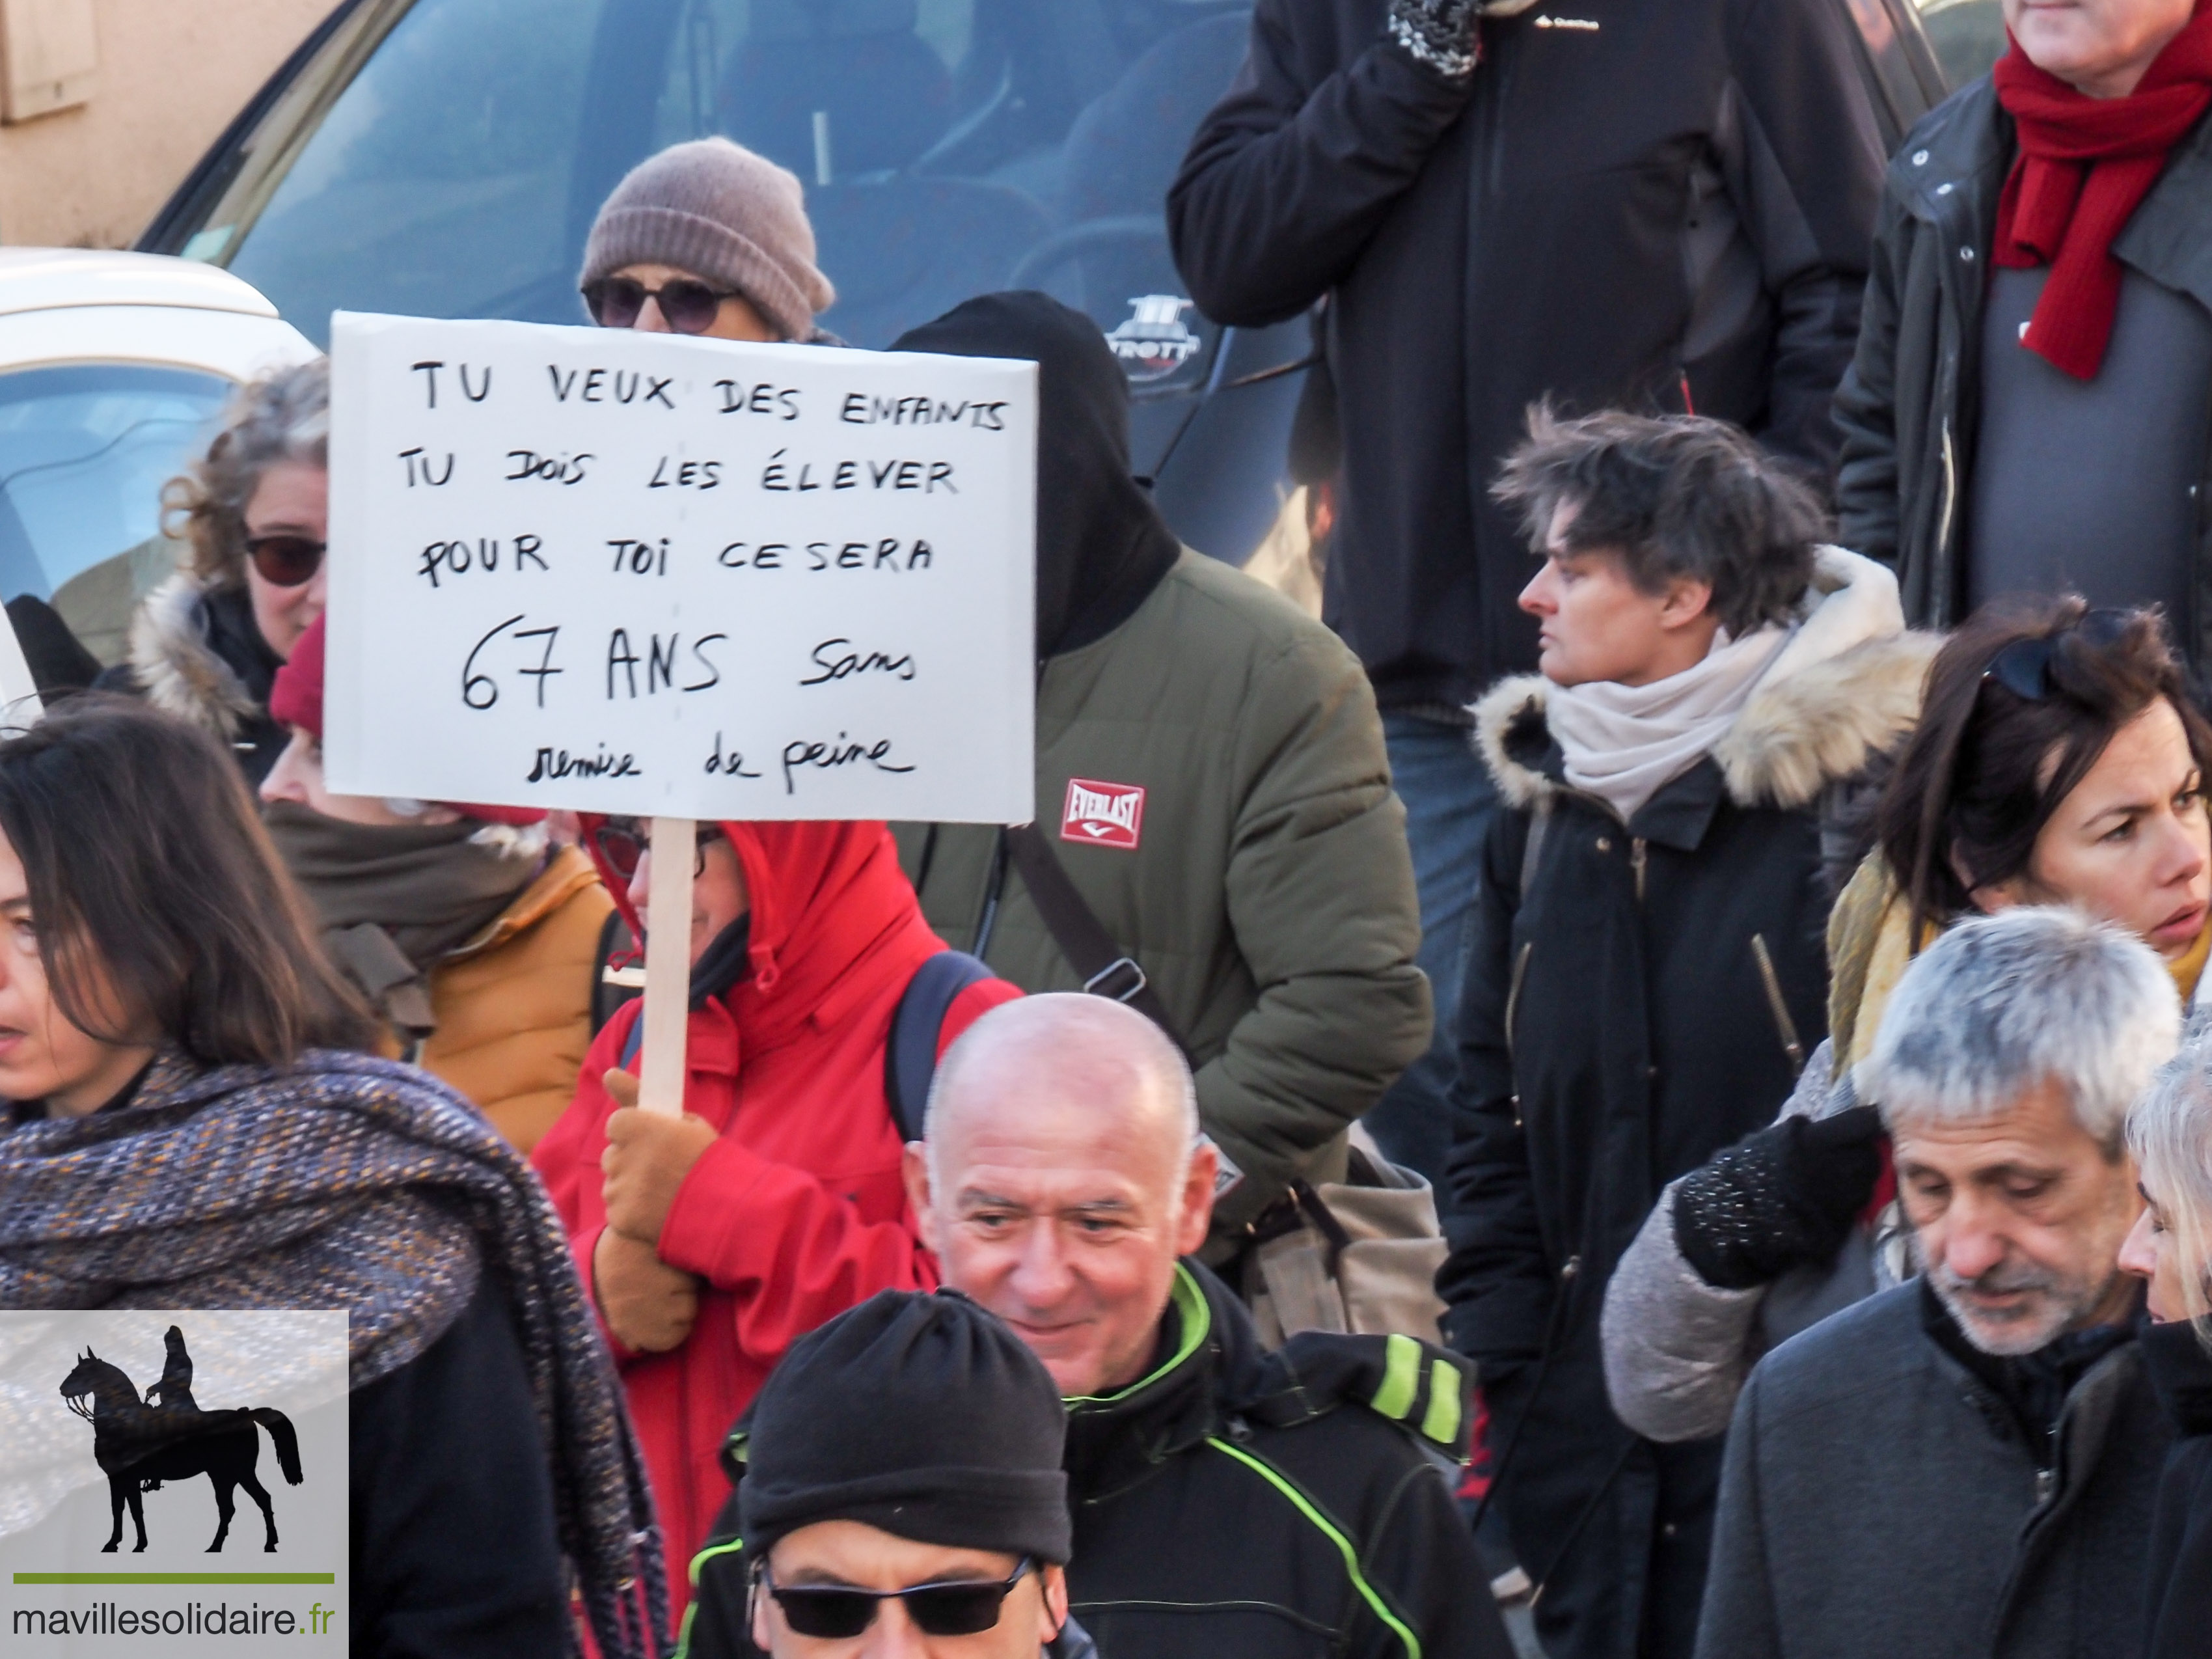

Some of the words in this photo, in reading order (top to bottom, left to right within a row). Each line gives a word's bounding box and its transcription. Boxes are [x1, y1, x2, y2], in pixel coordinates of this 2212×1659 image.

[410, 361, 491, 410] TU
[547, 363, 677, 411] VEUX
[712, 378, 802, 422] DES
[840, 392, 1011, 432] ENFANTS
[397, 446, 456, 488] TU
[646, 455, 724, 491] LES
[759, 447, 959, 494] ÉLEVER
[416, 534, 551, 589] POUR
[461, 614, 565, 711] 67
[607, 627, 730, 701] ANS
[525, 739, 643, 784] remise
[703, 730, 763, 779] de
[781, 731, 918, 797] peine
[1067, 784, 1140, 833] EVERLAST
